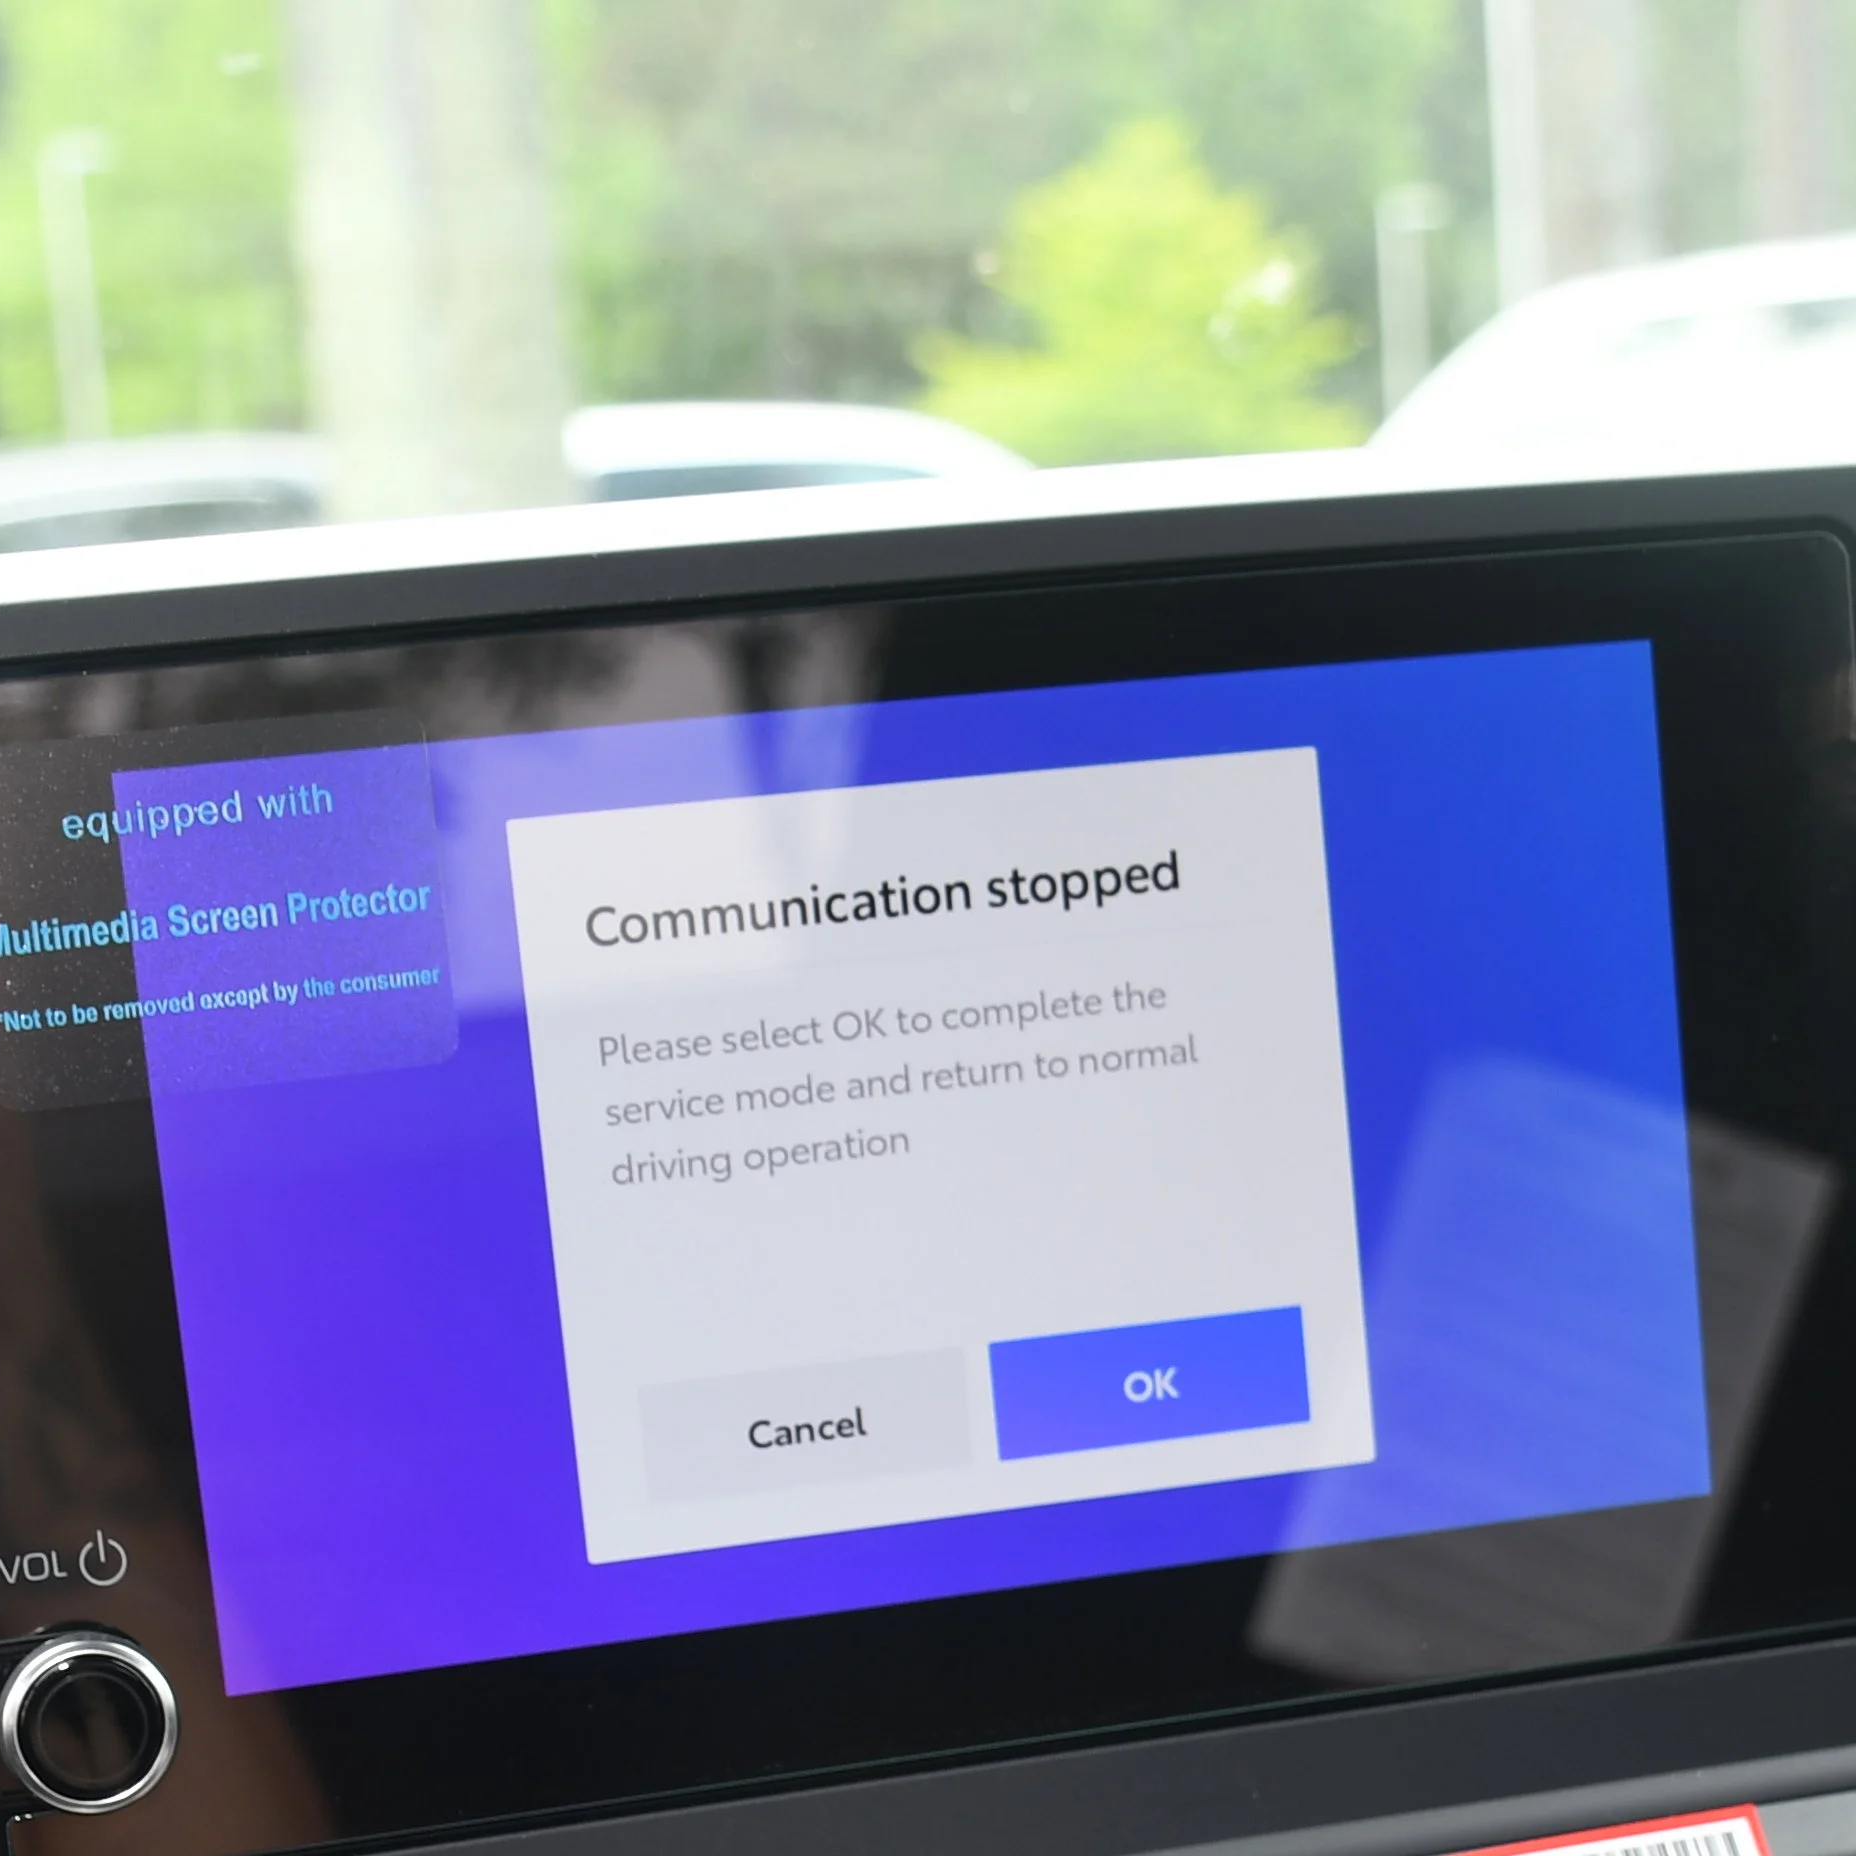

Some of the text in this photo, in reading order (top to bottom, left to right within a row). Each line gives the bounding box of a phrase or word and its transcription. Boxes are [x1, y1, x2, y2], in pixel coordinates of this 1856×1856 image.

[62, 783, 334, 844] equipped with
[168, 890, 278, 938] Screen
[288, 881, 431, 926] Protector
[585, 849, 1181, 947] Communication stopped
[45, 1007, 67, 1028] to
[73, 1002, 98, 1024] be
[104, 991, 195, 1021] removed
[200, 983, 270, 1012] except
[274, 979, 299, 1006] by
[303, 977, 336, 999] the
[340, 966, 441, 995] consumer
[598, 979, 1169, 1068] Please select OK to complete the
[605, 1034, 1200, 1127] service mode and return to normal
[611, 1127, 911, 1187] driving operation
[1123, 1367, 1180, 1403] OK
[748, 1407, 868, 1450] Cancel
